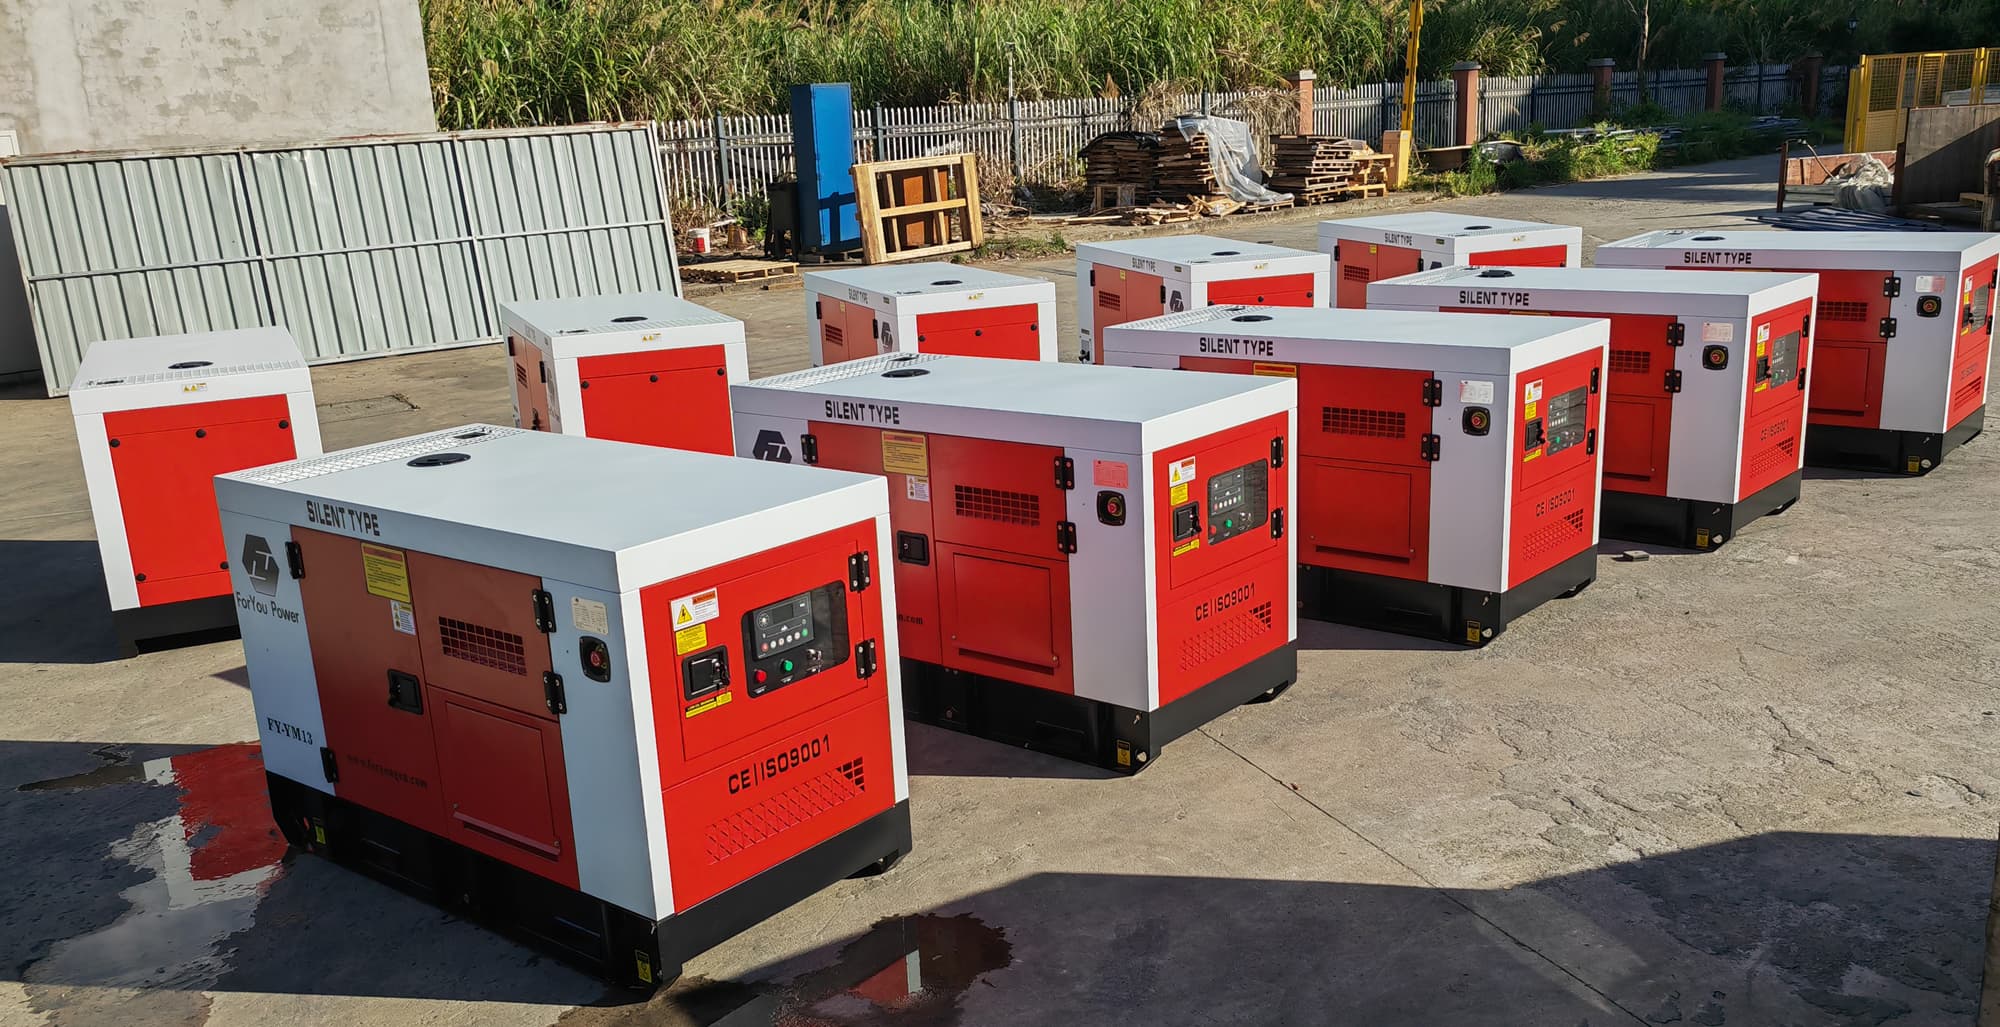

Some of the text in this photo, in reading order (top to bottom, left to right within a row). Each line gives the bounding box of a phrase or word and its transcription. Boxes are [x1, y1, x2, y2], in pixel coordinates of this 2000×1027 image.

[1683, 251, 1752, 265] SILENT TYPE
[1459, 290, 1530, 306] SILENT TYPE
[1200, 337, 1274, 356] SILENT TYPE
[825, 400, 900, 425] SILENT TYPE
[306, 500, 381, 537] SILENT TYPE
[236, 591, 300, 624] ForYou Power
[266, 716, 314, 746] FY-YM13
